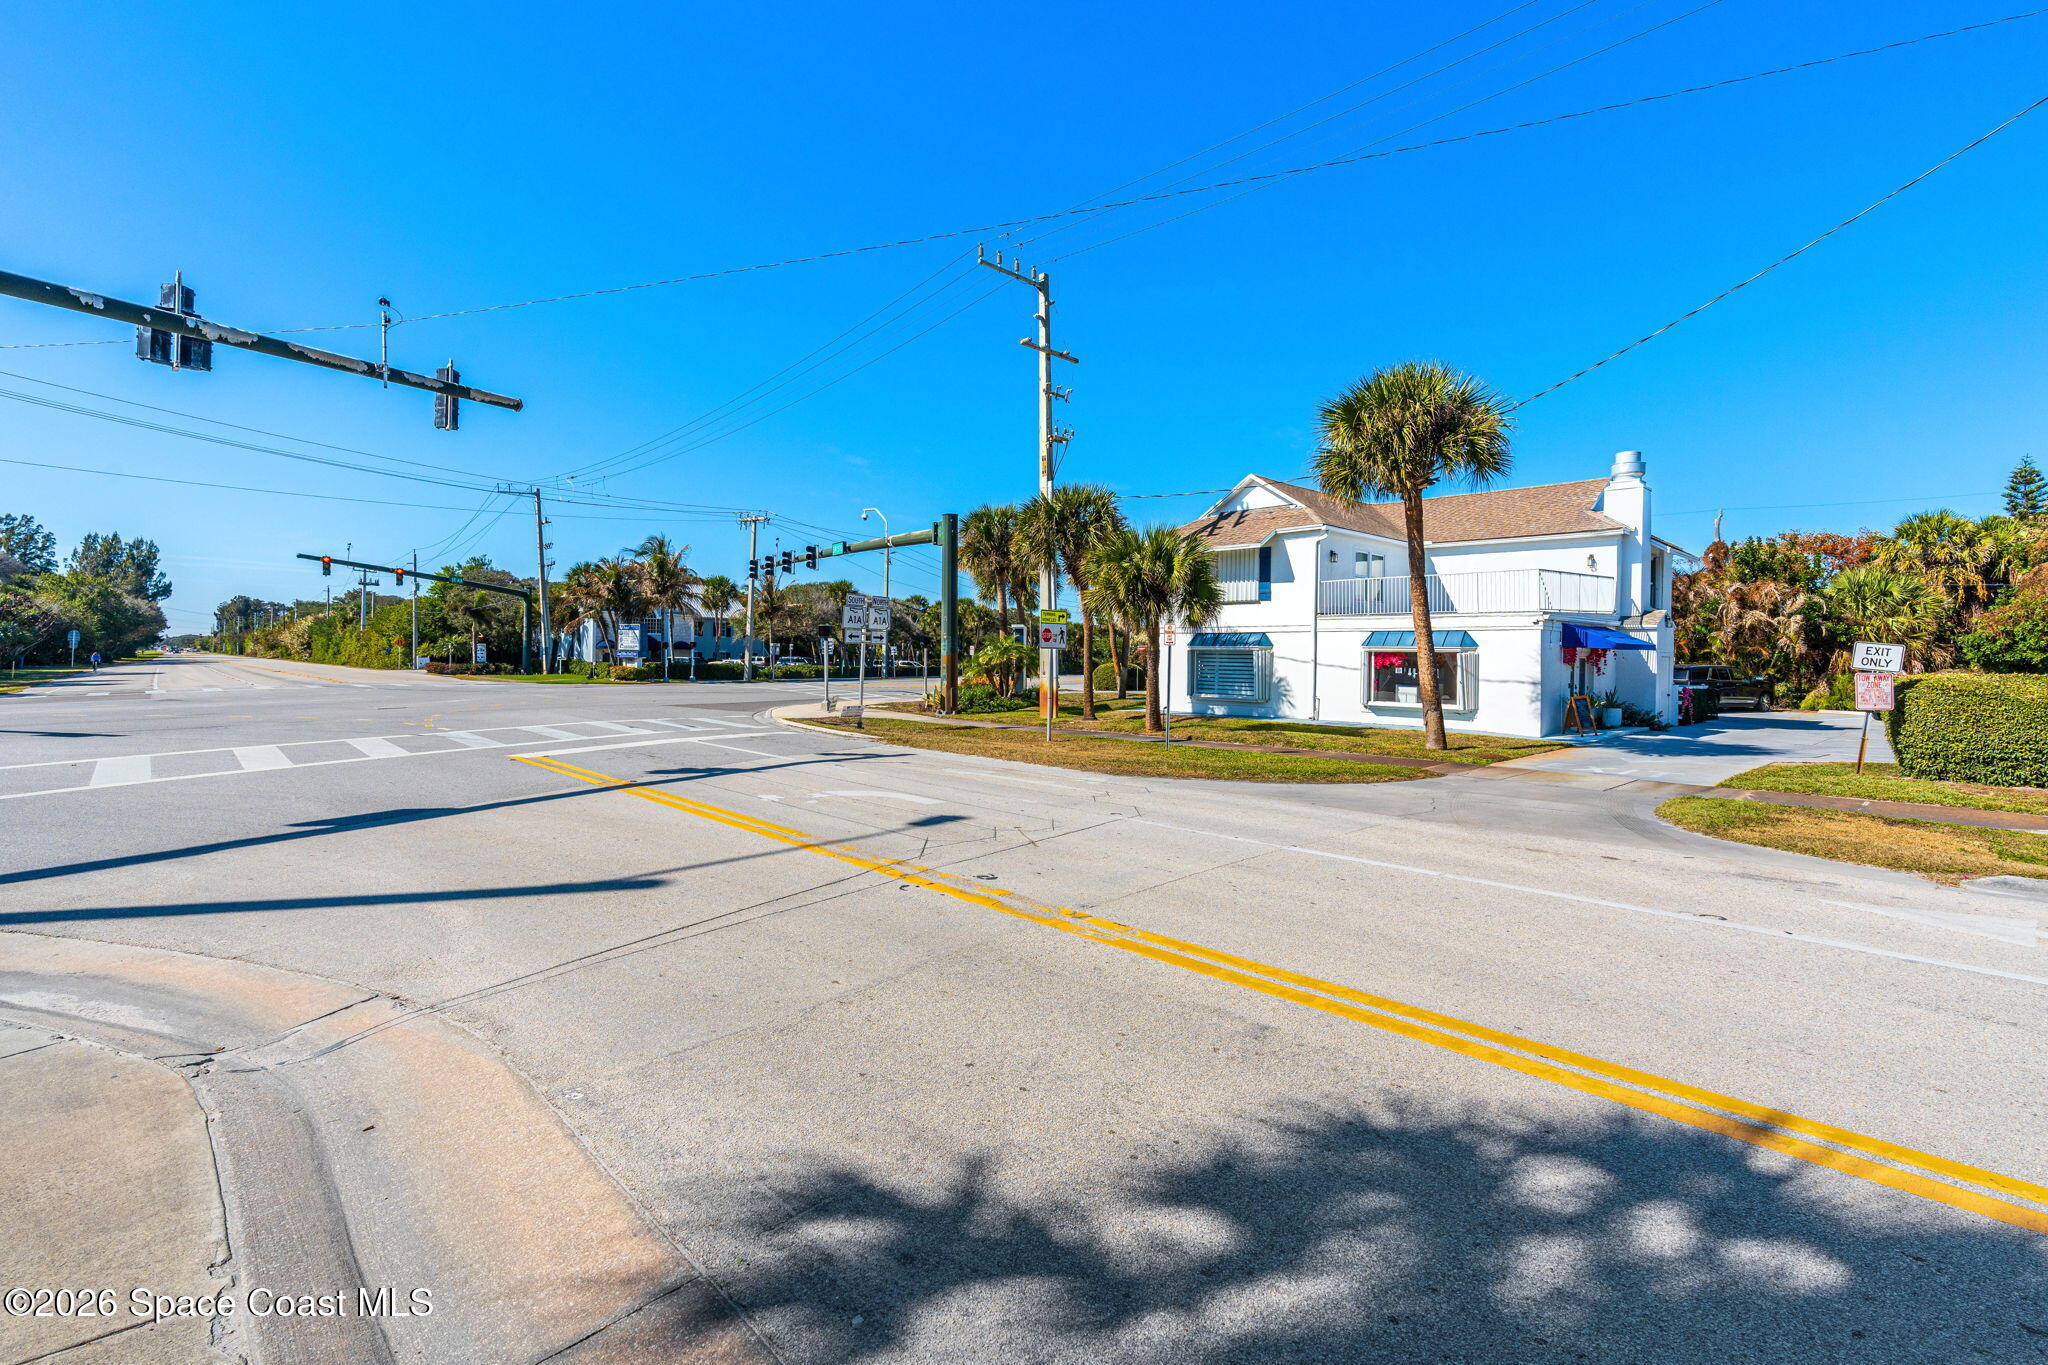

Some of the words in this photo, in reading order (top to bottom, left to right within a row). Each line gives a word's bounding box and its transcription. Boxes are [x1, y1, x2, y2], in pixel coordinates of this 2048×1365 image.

[848, 595, 864, 605] SOUTH
[873, 598, 889, 606] NORTH
[847, 615, 862, 624] A1A
[873, 617, 887, 625] A1A
[1865, 646, 1892, 657] EXIT
[1861, 657, 1892, 668] ONLY
